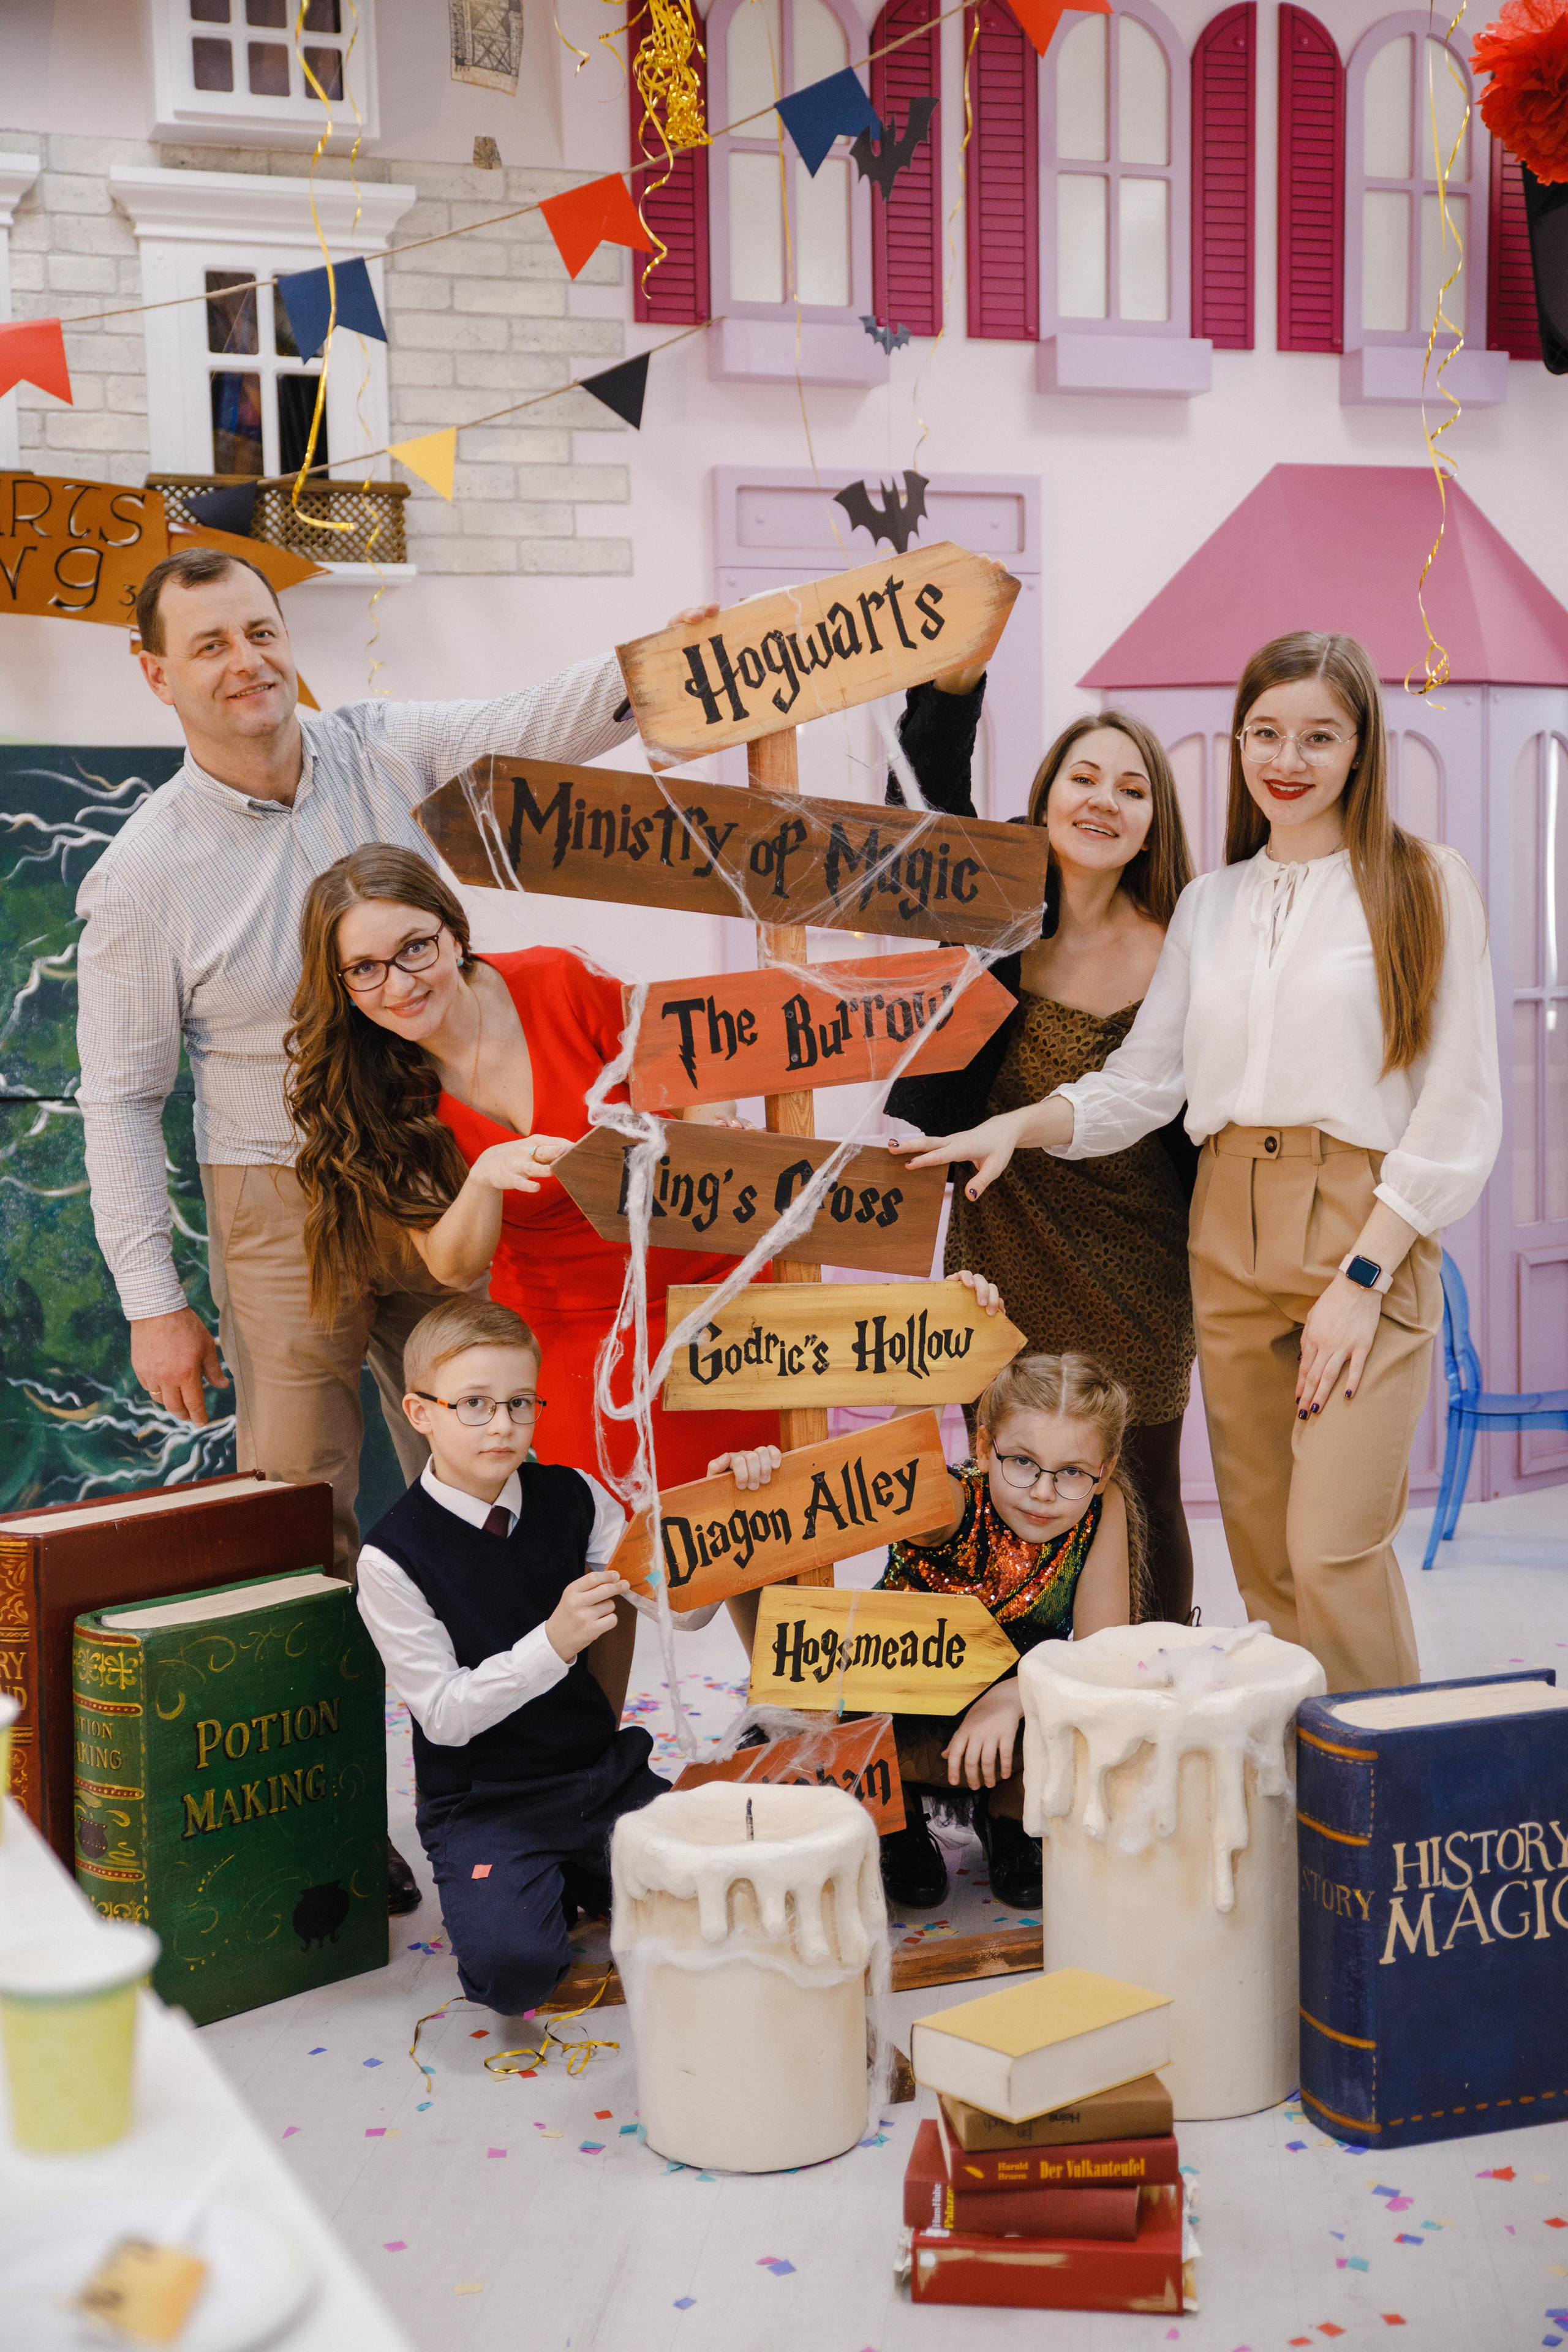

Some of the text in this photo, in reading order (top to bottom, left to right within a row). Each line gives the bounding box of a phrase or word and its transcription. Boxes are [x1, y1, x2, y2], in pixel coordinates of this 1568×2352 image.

[0, 480, 145, 547] RTS
[682, 574, 945, 725] Hogwarts
[508, 777, 980, 920] Ministry of Magic
[662, 995, 758, 1089] The
[851, 1308, 974, 1379] Hollow
[660, 1456, 919, 1588] Diagon Alley
[772, 1618, 967, 1683] Hogsmeade
[195, 1697, 341, 1770] POTION
[182, 1763, 326, 1839] MAKING
[1392, 1821, 1568, 1891] HISTORY
[1040, 2157, 1145, 2179] Der Vulkanteufel
